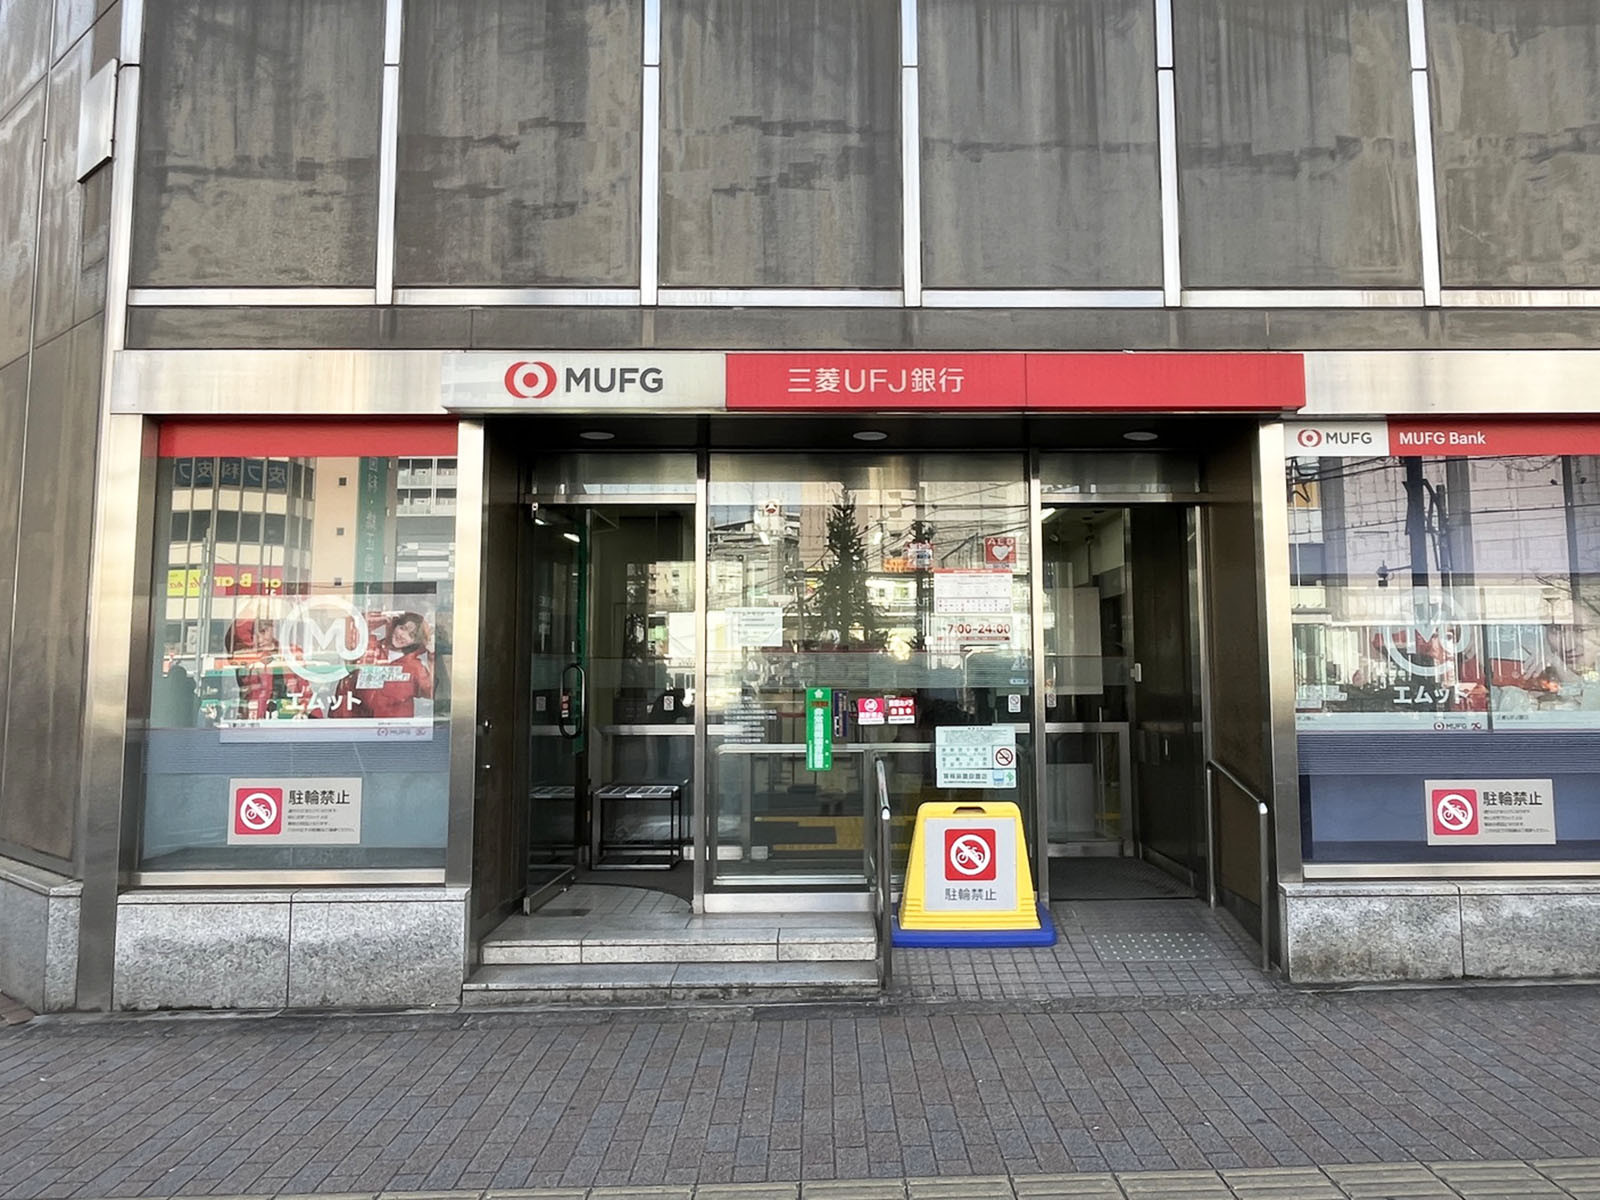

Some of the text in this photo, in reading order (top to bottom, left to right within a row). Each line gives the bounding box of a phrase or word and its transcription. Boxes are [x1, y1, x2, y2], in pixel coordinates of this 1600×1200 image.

[565, 367, 664, 393] MUFG
[787, 367, 965, 394] 三菱UFJ銀行
[1326, 432, 1372, 444] MUFG
[1399, 431, 1487, 445] MUFG Bank
[287, 691, 362, 712] エムット
[1393, 686, 1468, 705] エムット
[288, 789, 351, 805] 駐輪禁止
[1482, 791, 1543, 807] 駐輪禁止
[944, 887, 998, 902] 駐輪禁止
